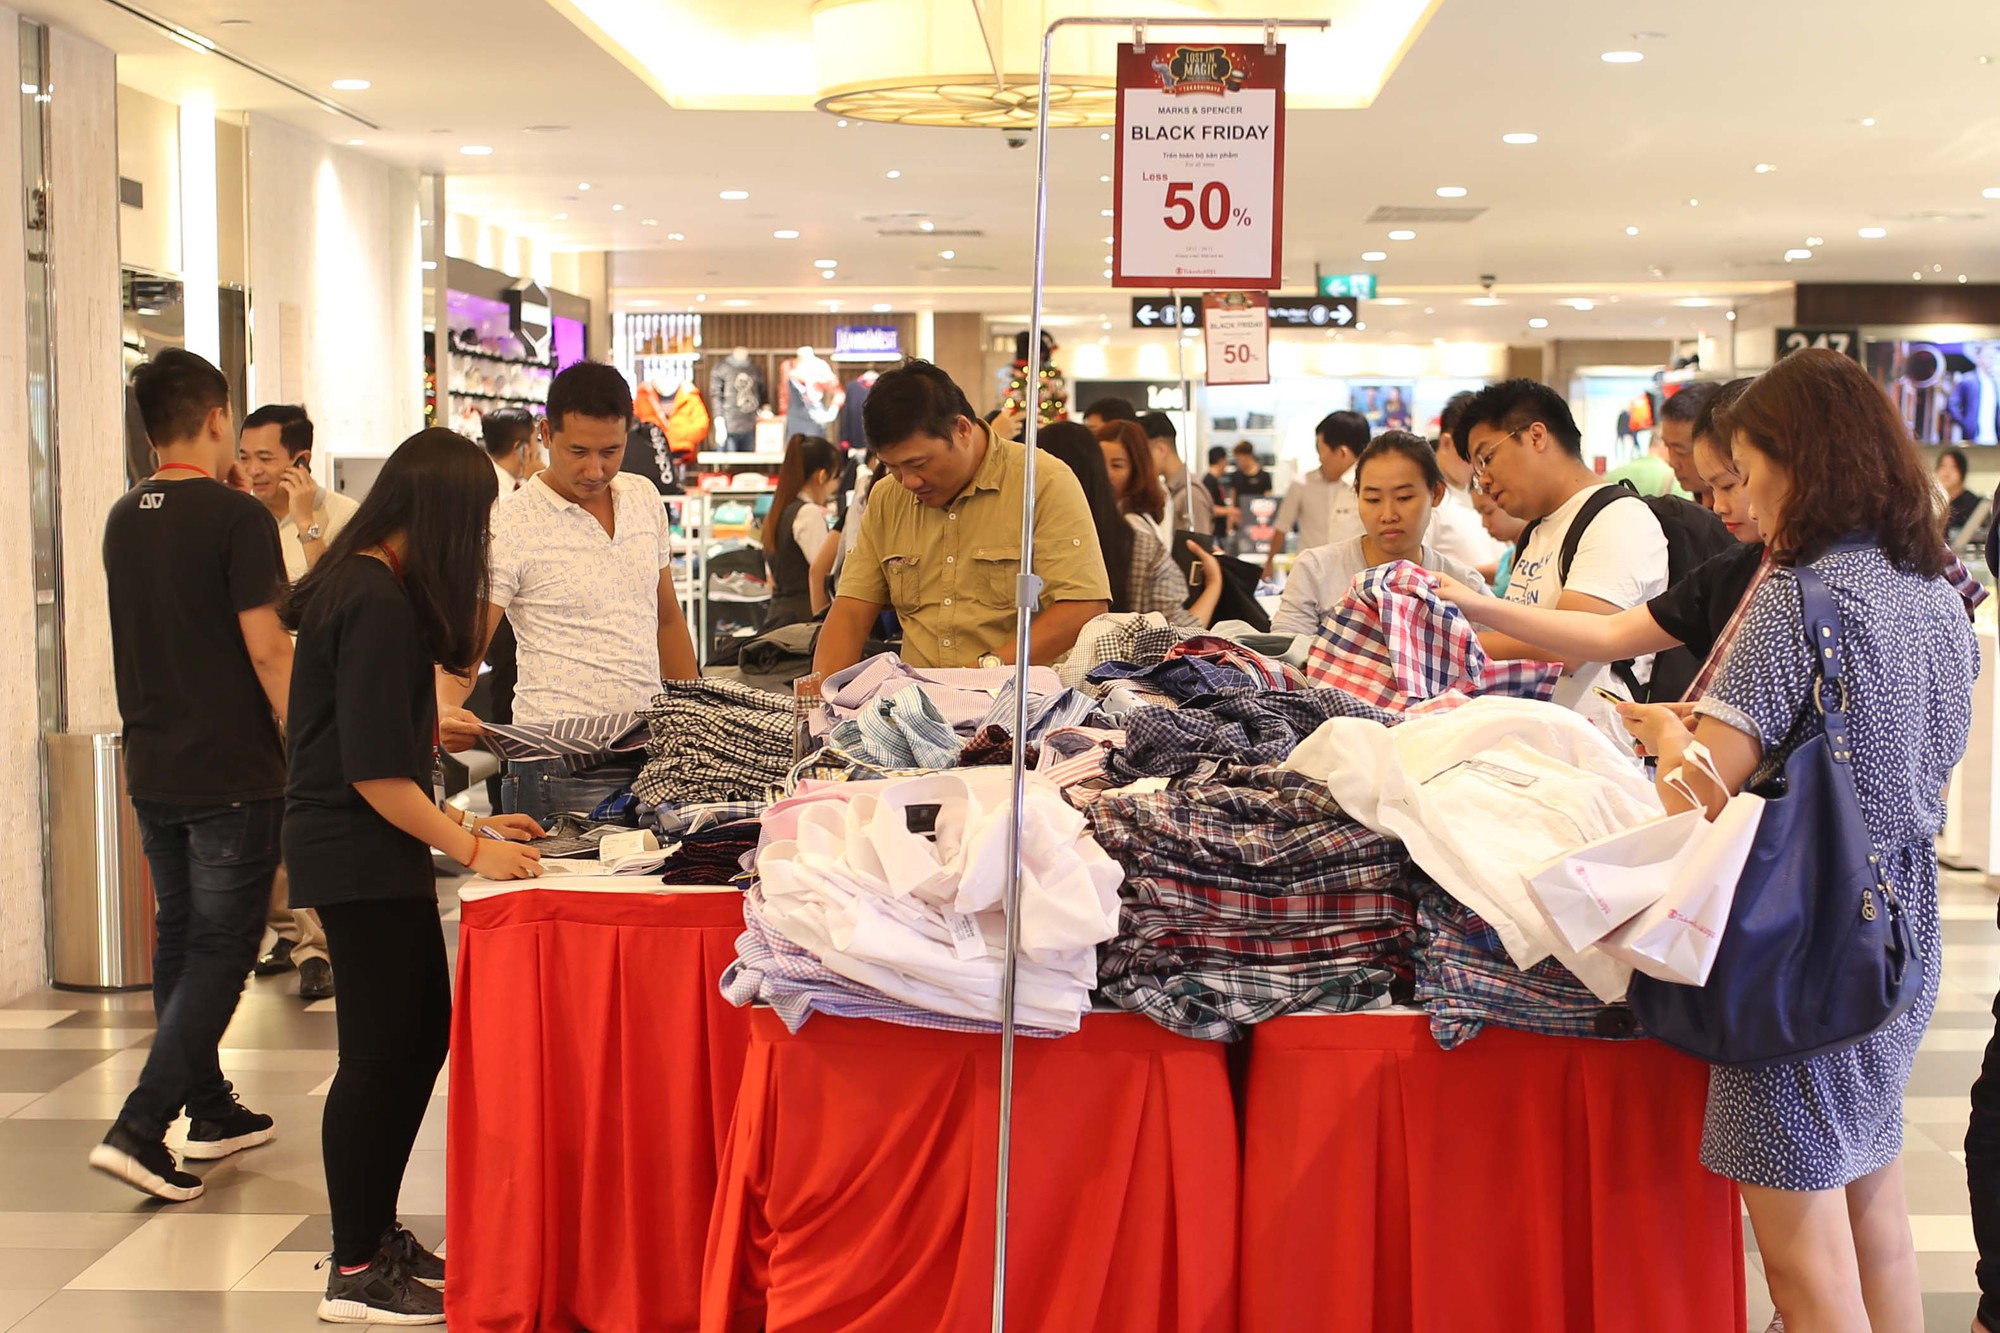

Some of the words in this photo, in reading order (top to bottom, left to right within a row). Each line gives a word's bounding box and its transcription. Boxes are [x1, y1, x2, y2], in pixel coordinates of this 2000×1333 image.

[1186, 52, 1203, 63] LOST
[1205, 52, 1215, 63] IN
[1182, 63, 1218, 79] MAGIC
[1158, 107, 1190, 115] MARKS
[1192, 107, 1198, 115] &
[1201, 107, 1243, 115] SPENCER
[1132, 126, 1195, 140] BLACK
[1202, 125, 1269, 140] FRIDAY
[1209, 322, 1235, 330] BLACK
[1237, 321, 1263, 329] FRIDAY
